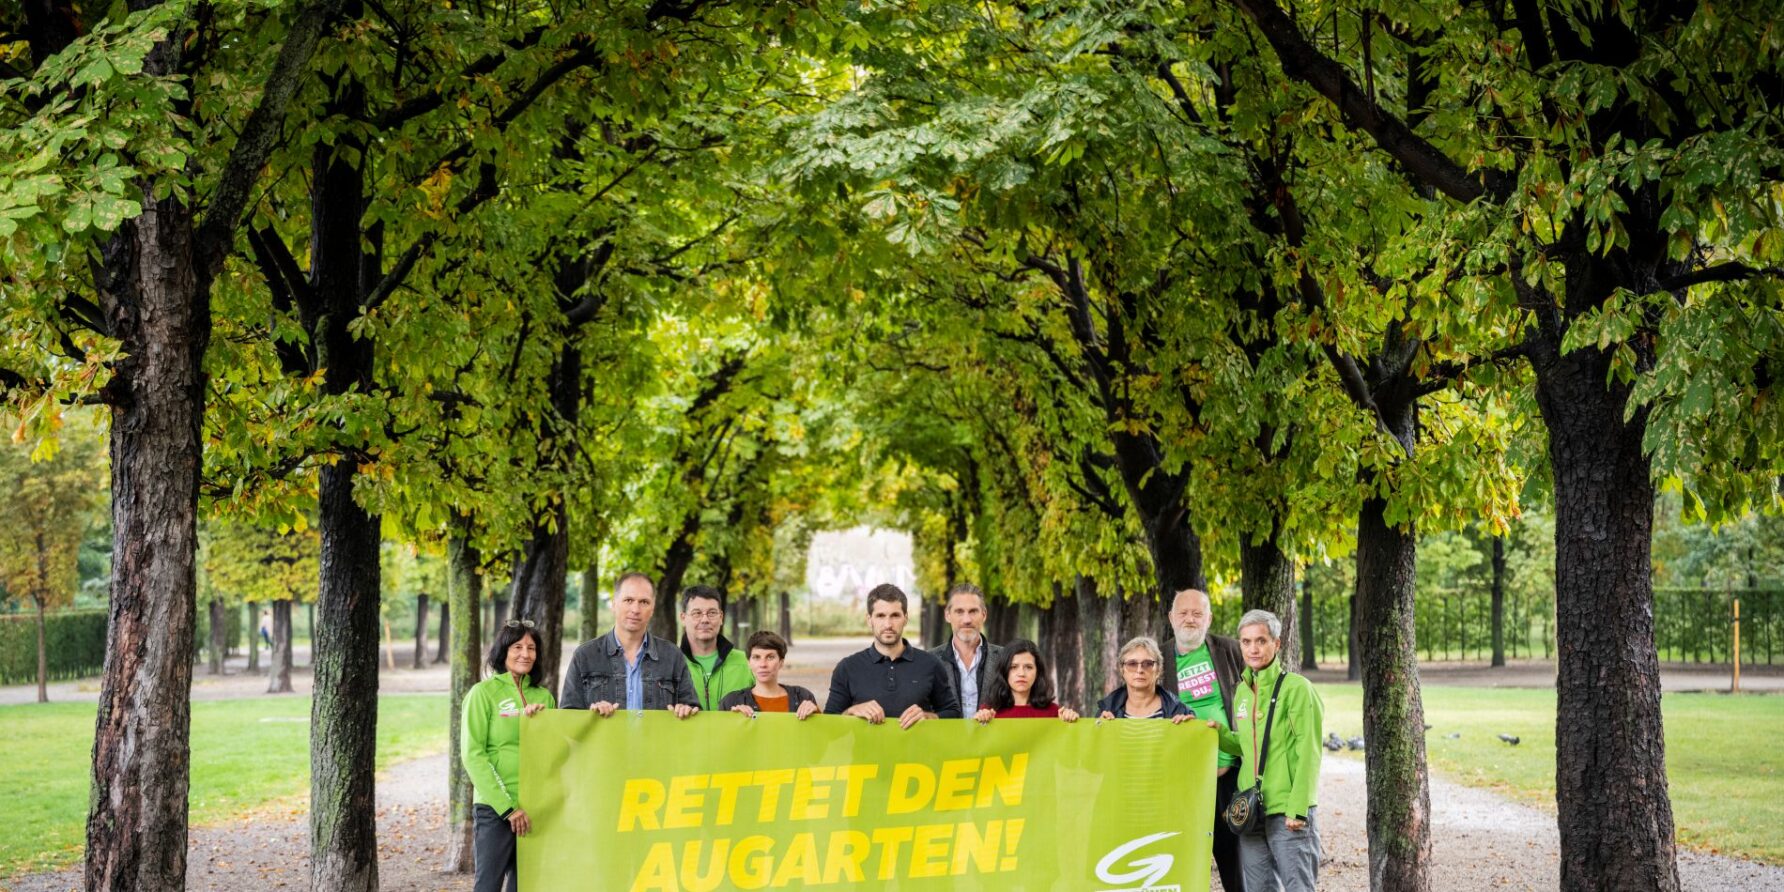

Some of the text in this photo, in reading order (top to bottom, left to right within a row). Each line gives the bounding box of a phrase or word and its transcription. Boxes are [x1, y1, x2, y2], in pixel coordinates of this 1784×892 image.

[1178, 671, 1216, 690] REDEST
[1179, 663, 1209, 679] JETZT
[617, 752, 1028, 832] RETTET DEN
[629, 818, 1025, 892] AUGARTEN!
